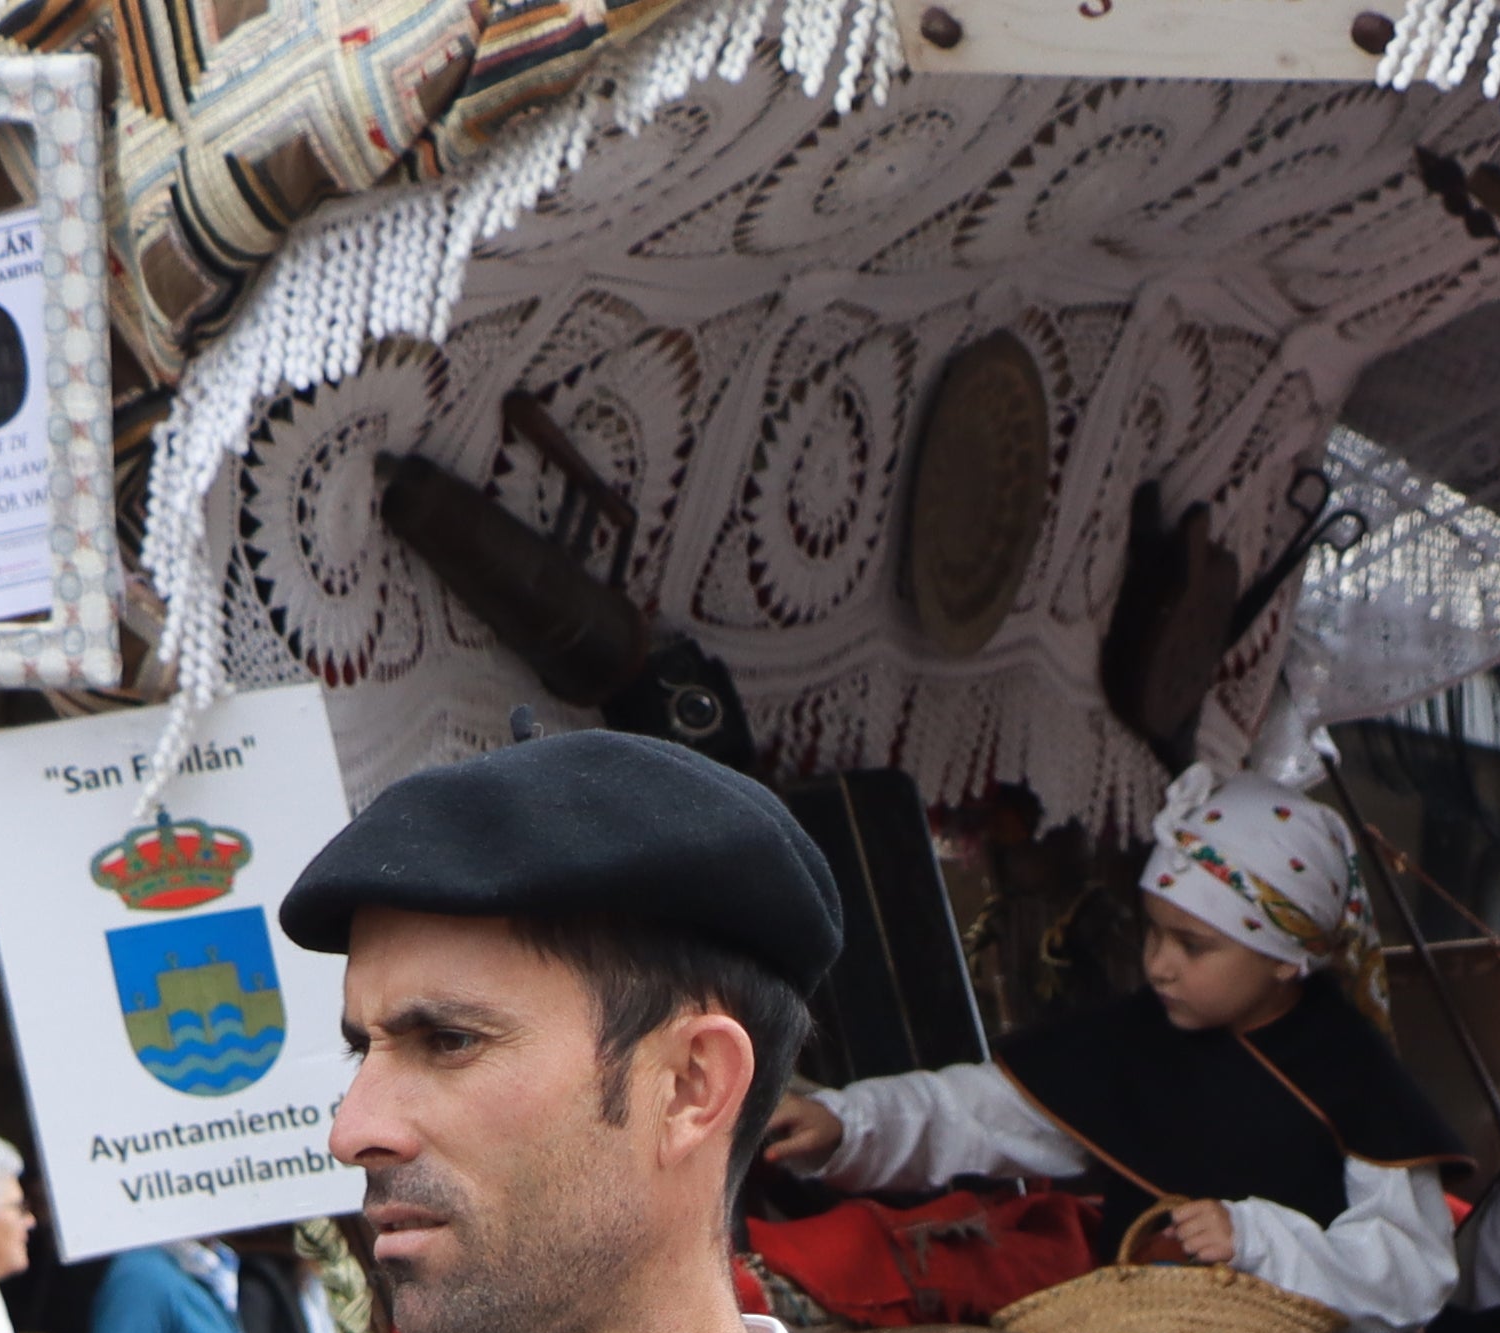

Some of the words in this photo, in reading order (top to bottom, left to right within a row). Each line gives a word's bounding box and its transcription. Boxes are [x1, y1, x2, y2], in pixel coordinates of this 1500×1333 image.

[45, 762, 123, 794] "San
[132, 734, 257, 783] Filán"
[89, 1103, 320, 1163] Ayuntamiento
[120, 1146, 336, 1203] Villaquilambr
